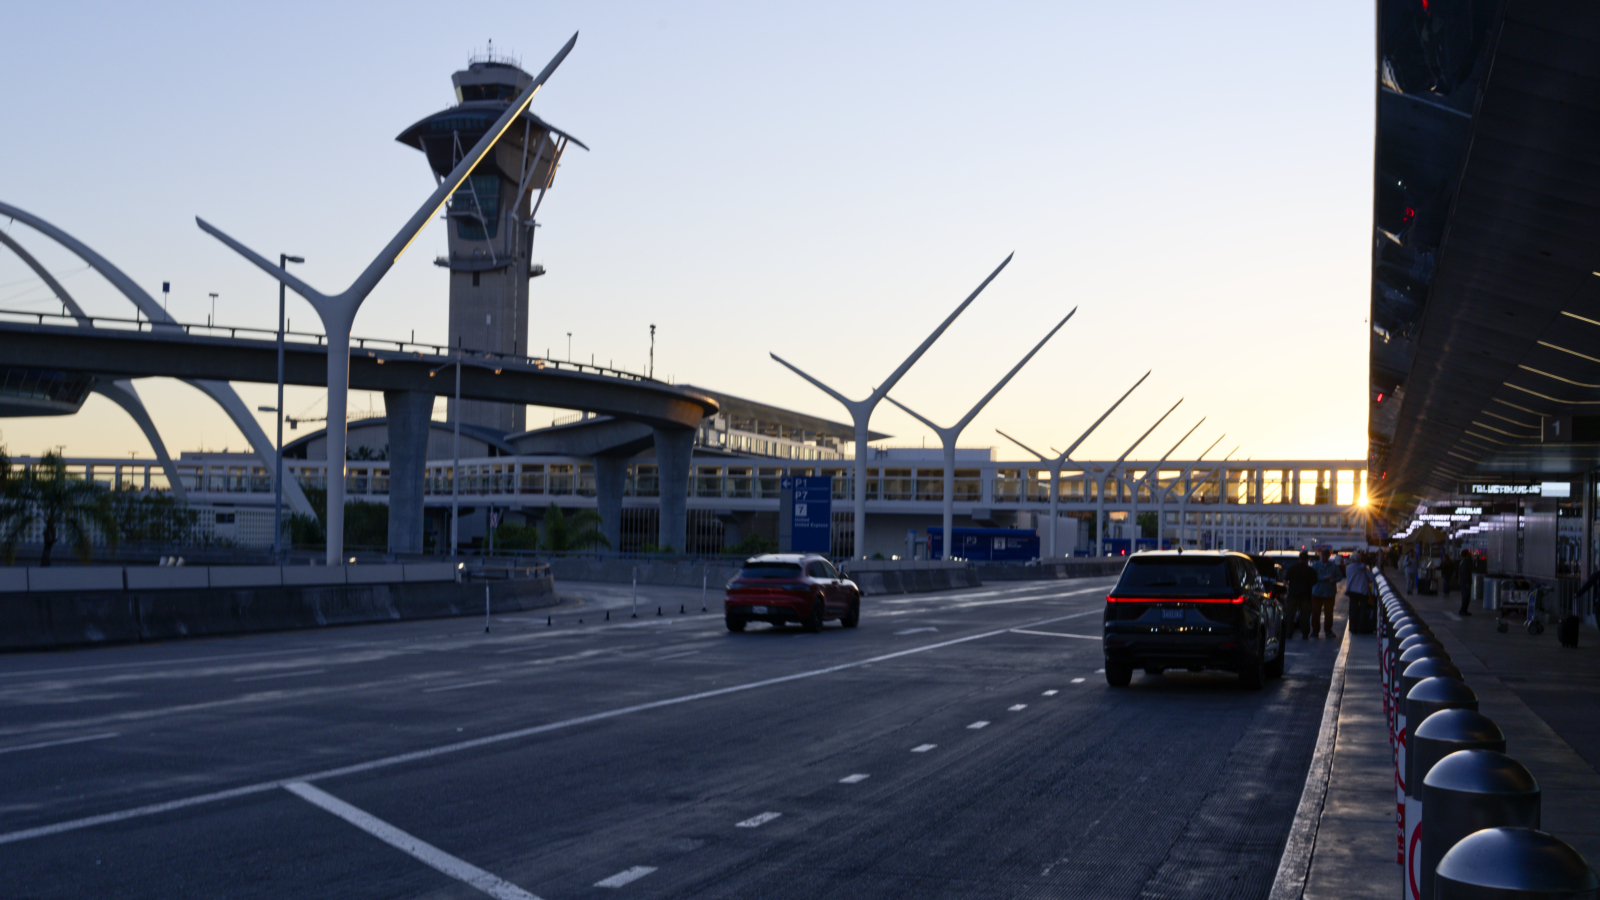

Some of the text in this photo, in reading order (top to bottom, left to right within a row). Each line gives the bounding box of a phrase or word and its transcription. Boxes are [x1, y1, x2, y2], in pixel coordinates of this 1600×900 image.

[1552, 420, 1560, 436] 1
[795, 478, 807, 488] P1
[795, 490, 808, 501] P7
[966, 535, 977, 545] P3
